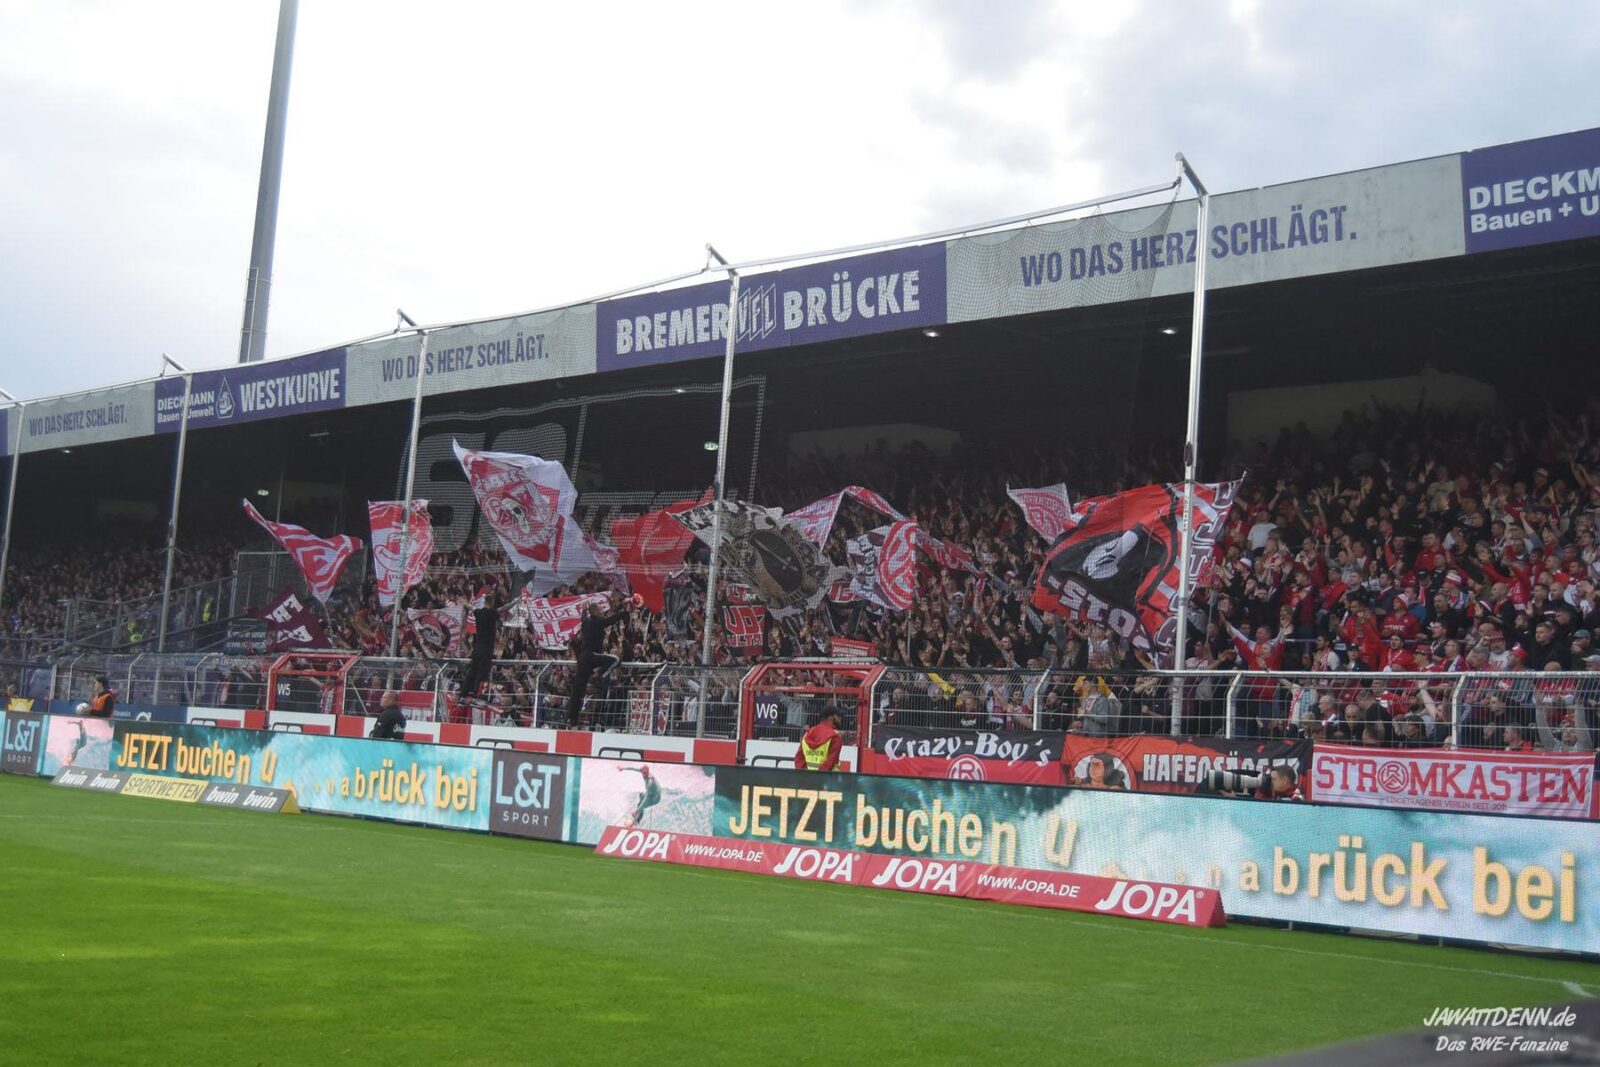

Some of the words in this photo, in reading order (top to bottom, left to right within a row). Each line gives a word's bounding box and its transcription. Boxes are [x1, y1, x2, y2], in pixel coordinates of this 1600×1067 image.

[1471, 206, 1551, 233] Bauen
[1021, 251, 1062, 287] WO
[1070, 242, 1123, 280] DAS
[1131, 230, 1198, 271] HERZ
[1211, 205, 1357, 258] SCHLÄGT.
[616, 303, 729, 354] BREMER
[783, 270, 920, 330] BRÜCKE
[382, 358, 403, 382] WO
[437, 344, 474, 374] HERZ
[477, 333, 549, 369] SCHLÄGT.
[240, 368, 341, 412] WESTKURVE
[29, 418, 43, 437] WO
[45, 415, 62, 435] DAS
[63, 412, 84, 432] HERZ
[157, 413, 180, 424] Bauen
[277, 684, 291, 697] W5
[755, 703, 778, 720] W6
[5, 719, 39, 752] L&T
[8, 754, 31, 764] SPORT
[117, 733, 172, 769] JETZT
[175, 737, 250, 784] buchen
[59, 769, 88, 786] bwin
[90, 772, 121, 790] bwin
[125, 776, 204, 801] SPORTWETTEN
[435, 765, 478, 812] bei
[496, 760, 560, 809] L&T
[206, 786, 240, 804] bwin
[243, 790, 279, 809] bwin
[1445, 800, 1470, 809] VEREIN
[503, 811, 549, 826] SPORT
[728, 785, 842, 842] JETZT
[855, 793, 1017, 867] buchen
[684, 843, 763, 863] WWW.JOPA.DE
[977, 874, 1080, 898] WWW.JOPA.DE
[1472, 847, 1575, 922] bei
